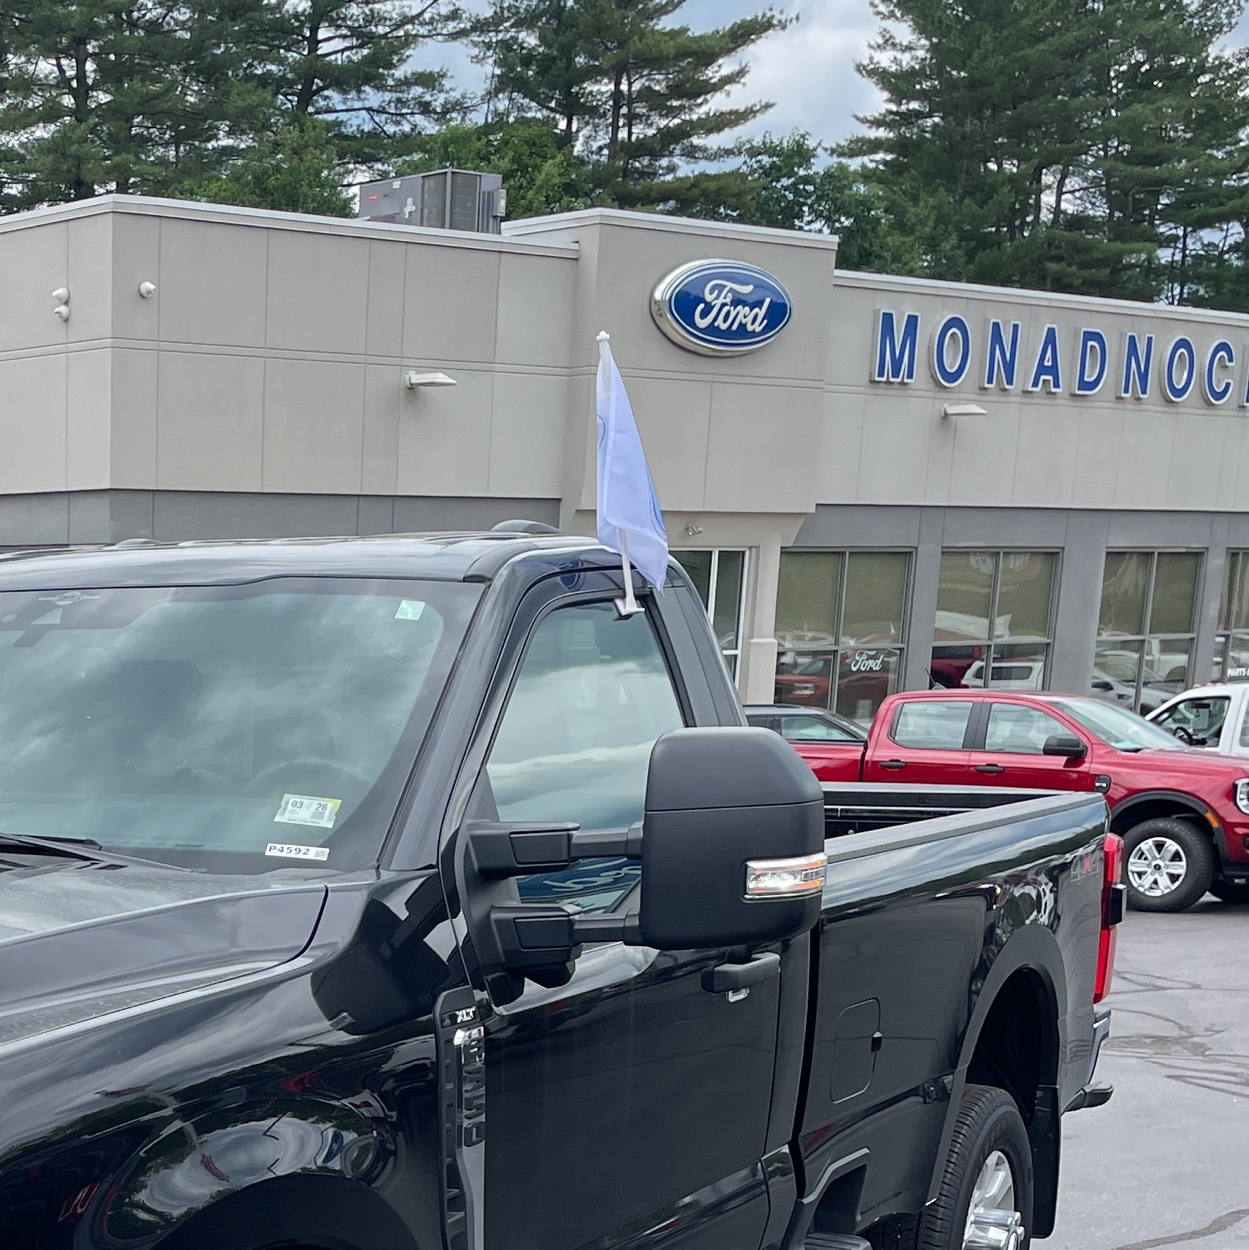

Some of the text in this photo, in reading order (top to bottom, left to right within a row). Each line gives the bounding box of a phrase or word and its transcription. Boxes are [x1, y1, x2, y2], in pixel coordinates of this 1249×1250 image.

[694, 279, 771, 333] Ford
[870, 309, 1249, 406] MONADNOC
[850, 650, 885, 672] Ford
[291, 800, 304, 809] 03
[315, 802, 329, 812] 26
[268, 845, 310, 856] P4592
[455, 1005, 476, 1023] XLT
